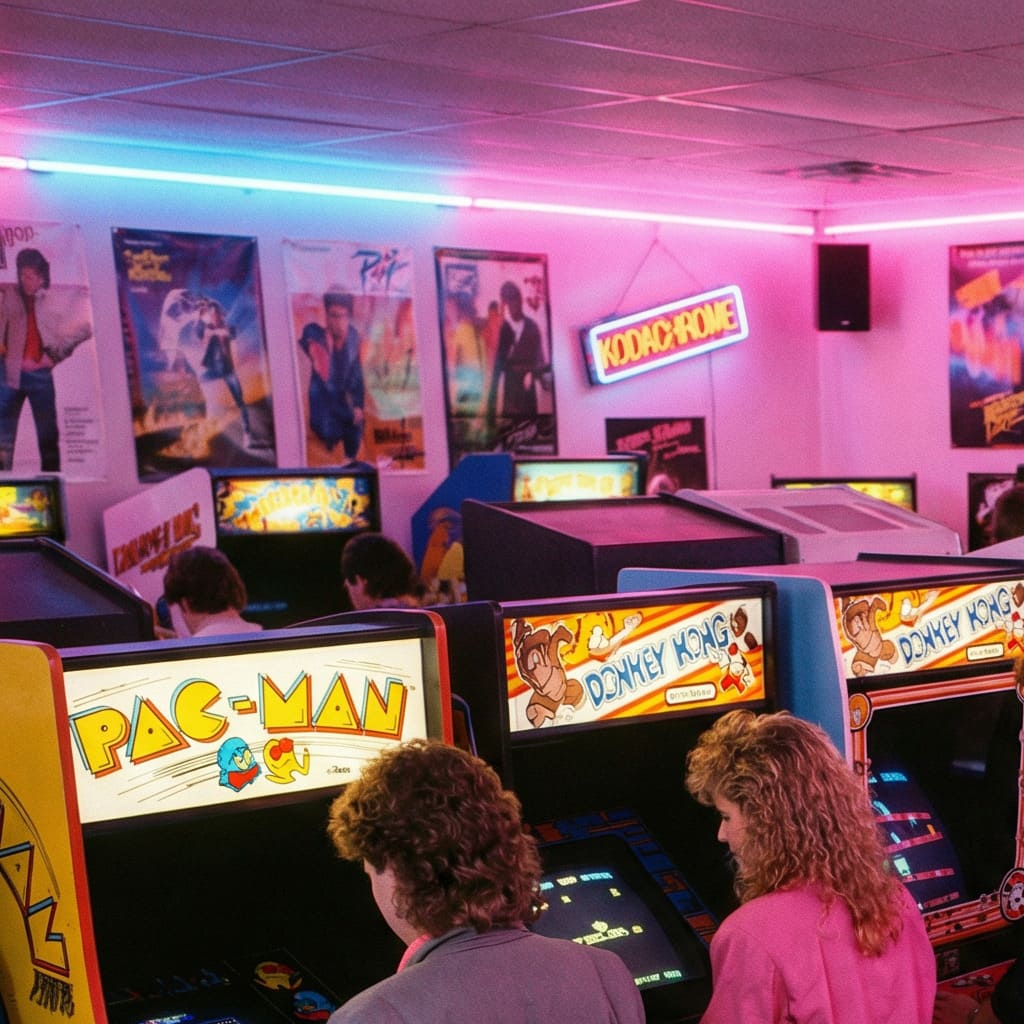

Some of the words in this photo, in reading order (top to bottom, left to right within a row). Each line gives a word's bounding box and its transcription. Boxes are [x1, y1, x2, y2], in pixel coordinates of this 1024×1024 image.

[584, 642, 666, 708] DONKEY
[671, 613, 730, 668] KONG
[900, 610, 962, 665] DONKEY
[967, 586, 1012, 633] KONG
[69, 670, 408, 778] PAC-MAN
